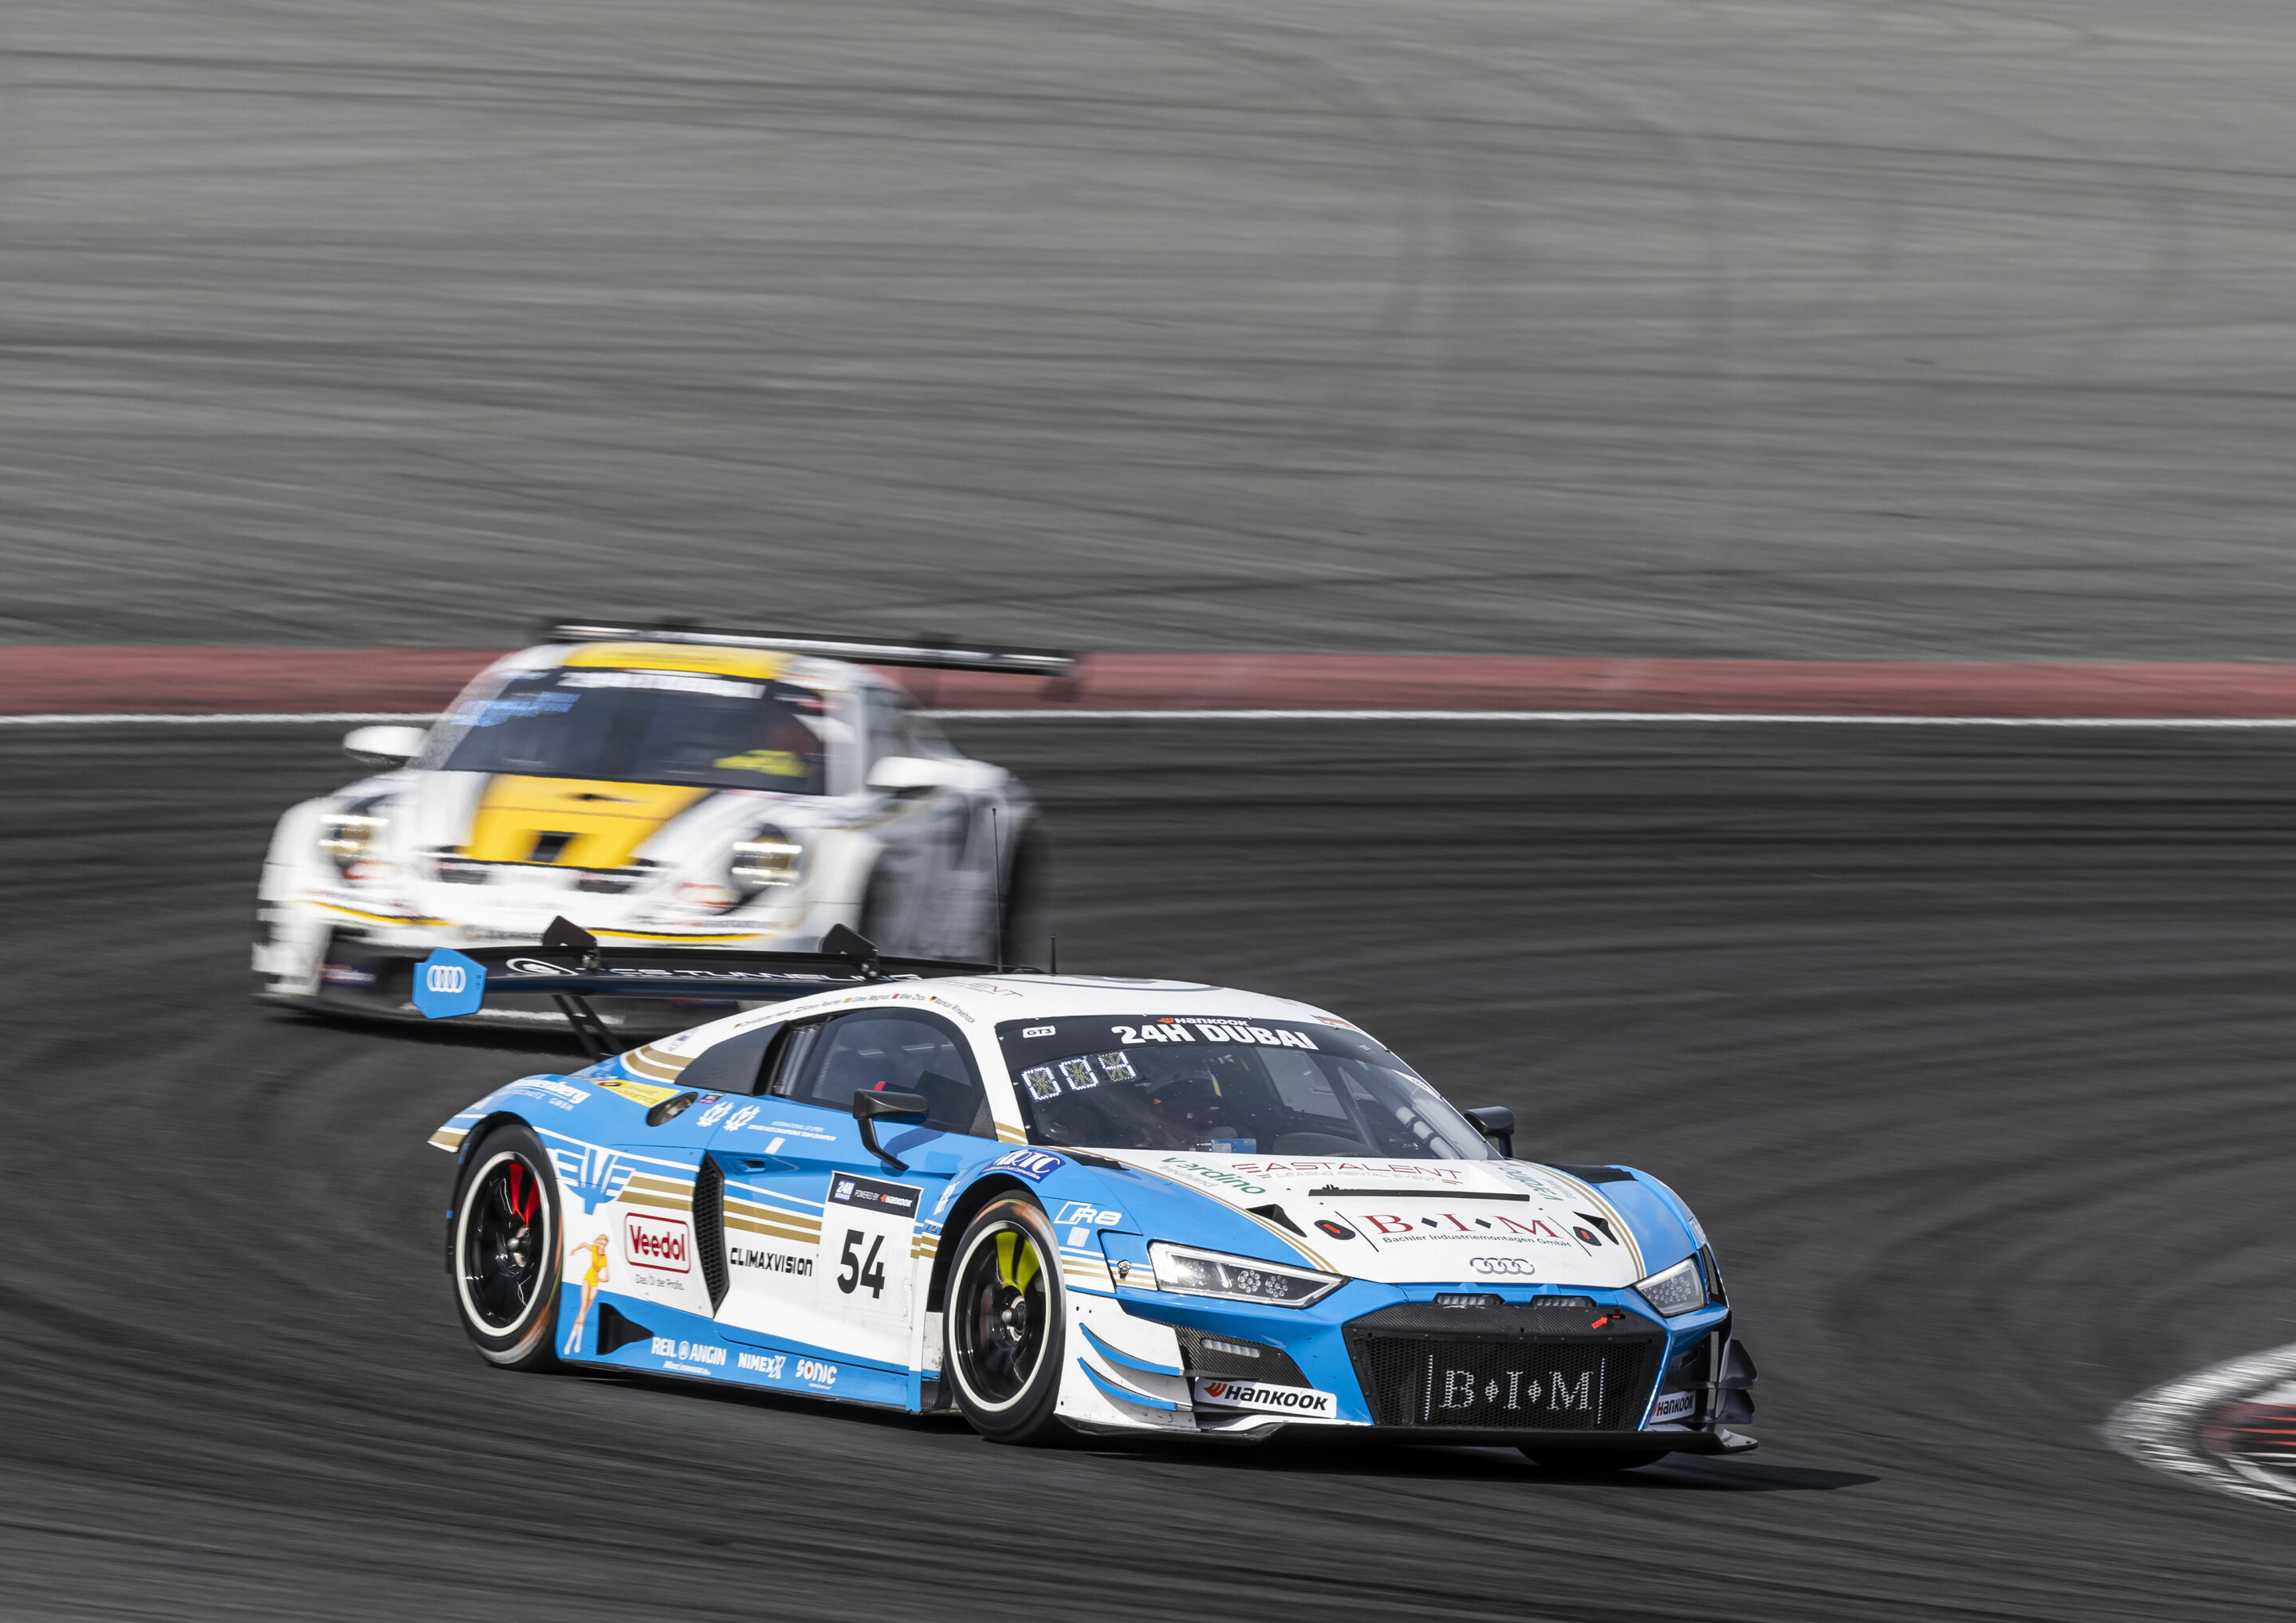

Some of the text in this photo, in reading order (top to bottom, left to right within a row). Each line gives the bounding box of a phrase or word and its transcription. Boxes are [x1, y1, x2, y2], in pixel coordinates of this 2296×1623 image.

[1111, 1024, 1319, 1051] 24H DUBAI
[836, 1181, 855, 1195] 24H
[1070, 1208, 1122, 1226] R8
[629, 1224, 686, 1262] Veedol
[1429, 1234, 1535, 1244] Industriemontagen
[1536, 1237, 1572, 1248] GmbH
[729, 1247, 813, 1277] CLIMAXVISION
[837, 1228, 886, 1299] 54
[690, 1343, 727, 1366] ANGIN
[796, 1358, 837, 1385] SONIC
